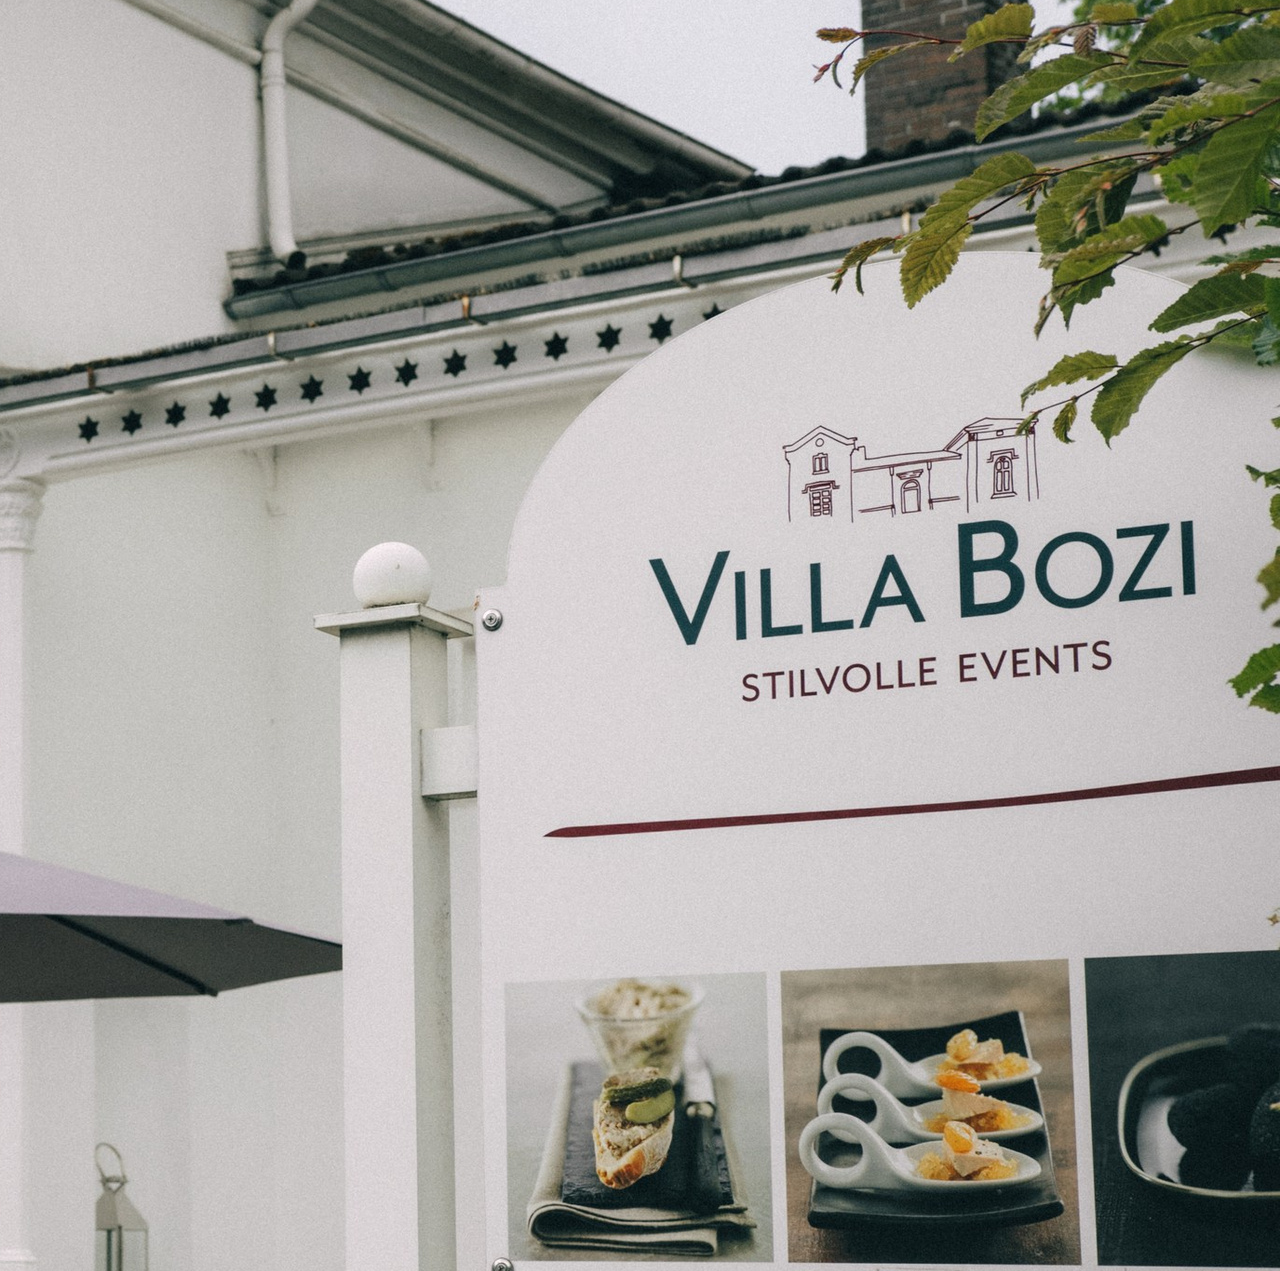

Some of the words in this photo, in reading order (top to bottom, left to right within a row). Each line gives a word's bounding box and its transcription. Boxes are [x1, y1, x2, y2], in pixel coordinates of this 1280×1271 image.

[649, 550, 926, 646] VILLA
[957, 519, 1196, 618] BOZI
[742, 656, 938, 702] STILVOLLE
[958, 640, 1112, 683] EVENTS
